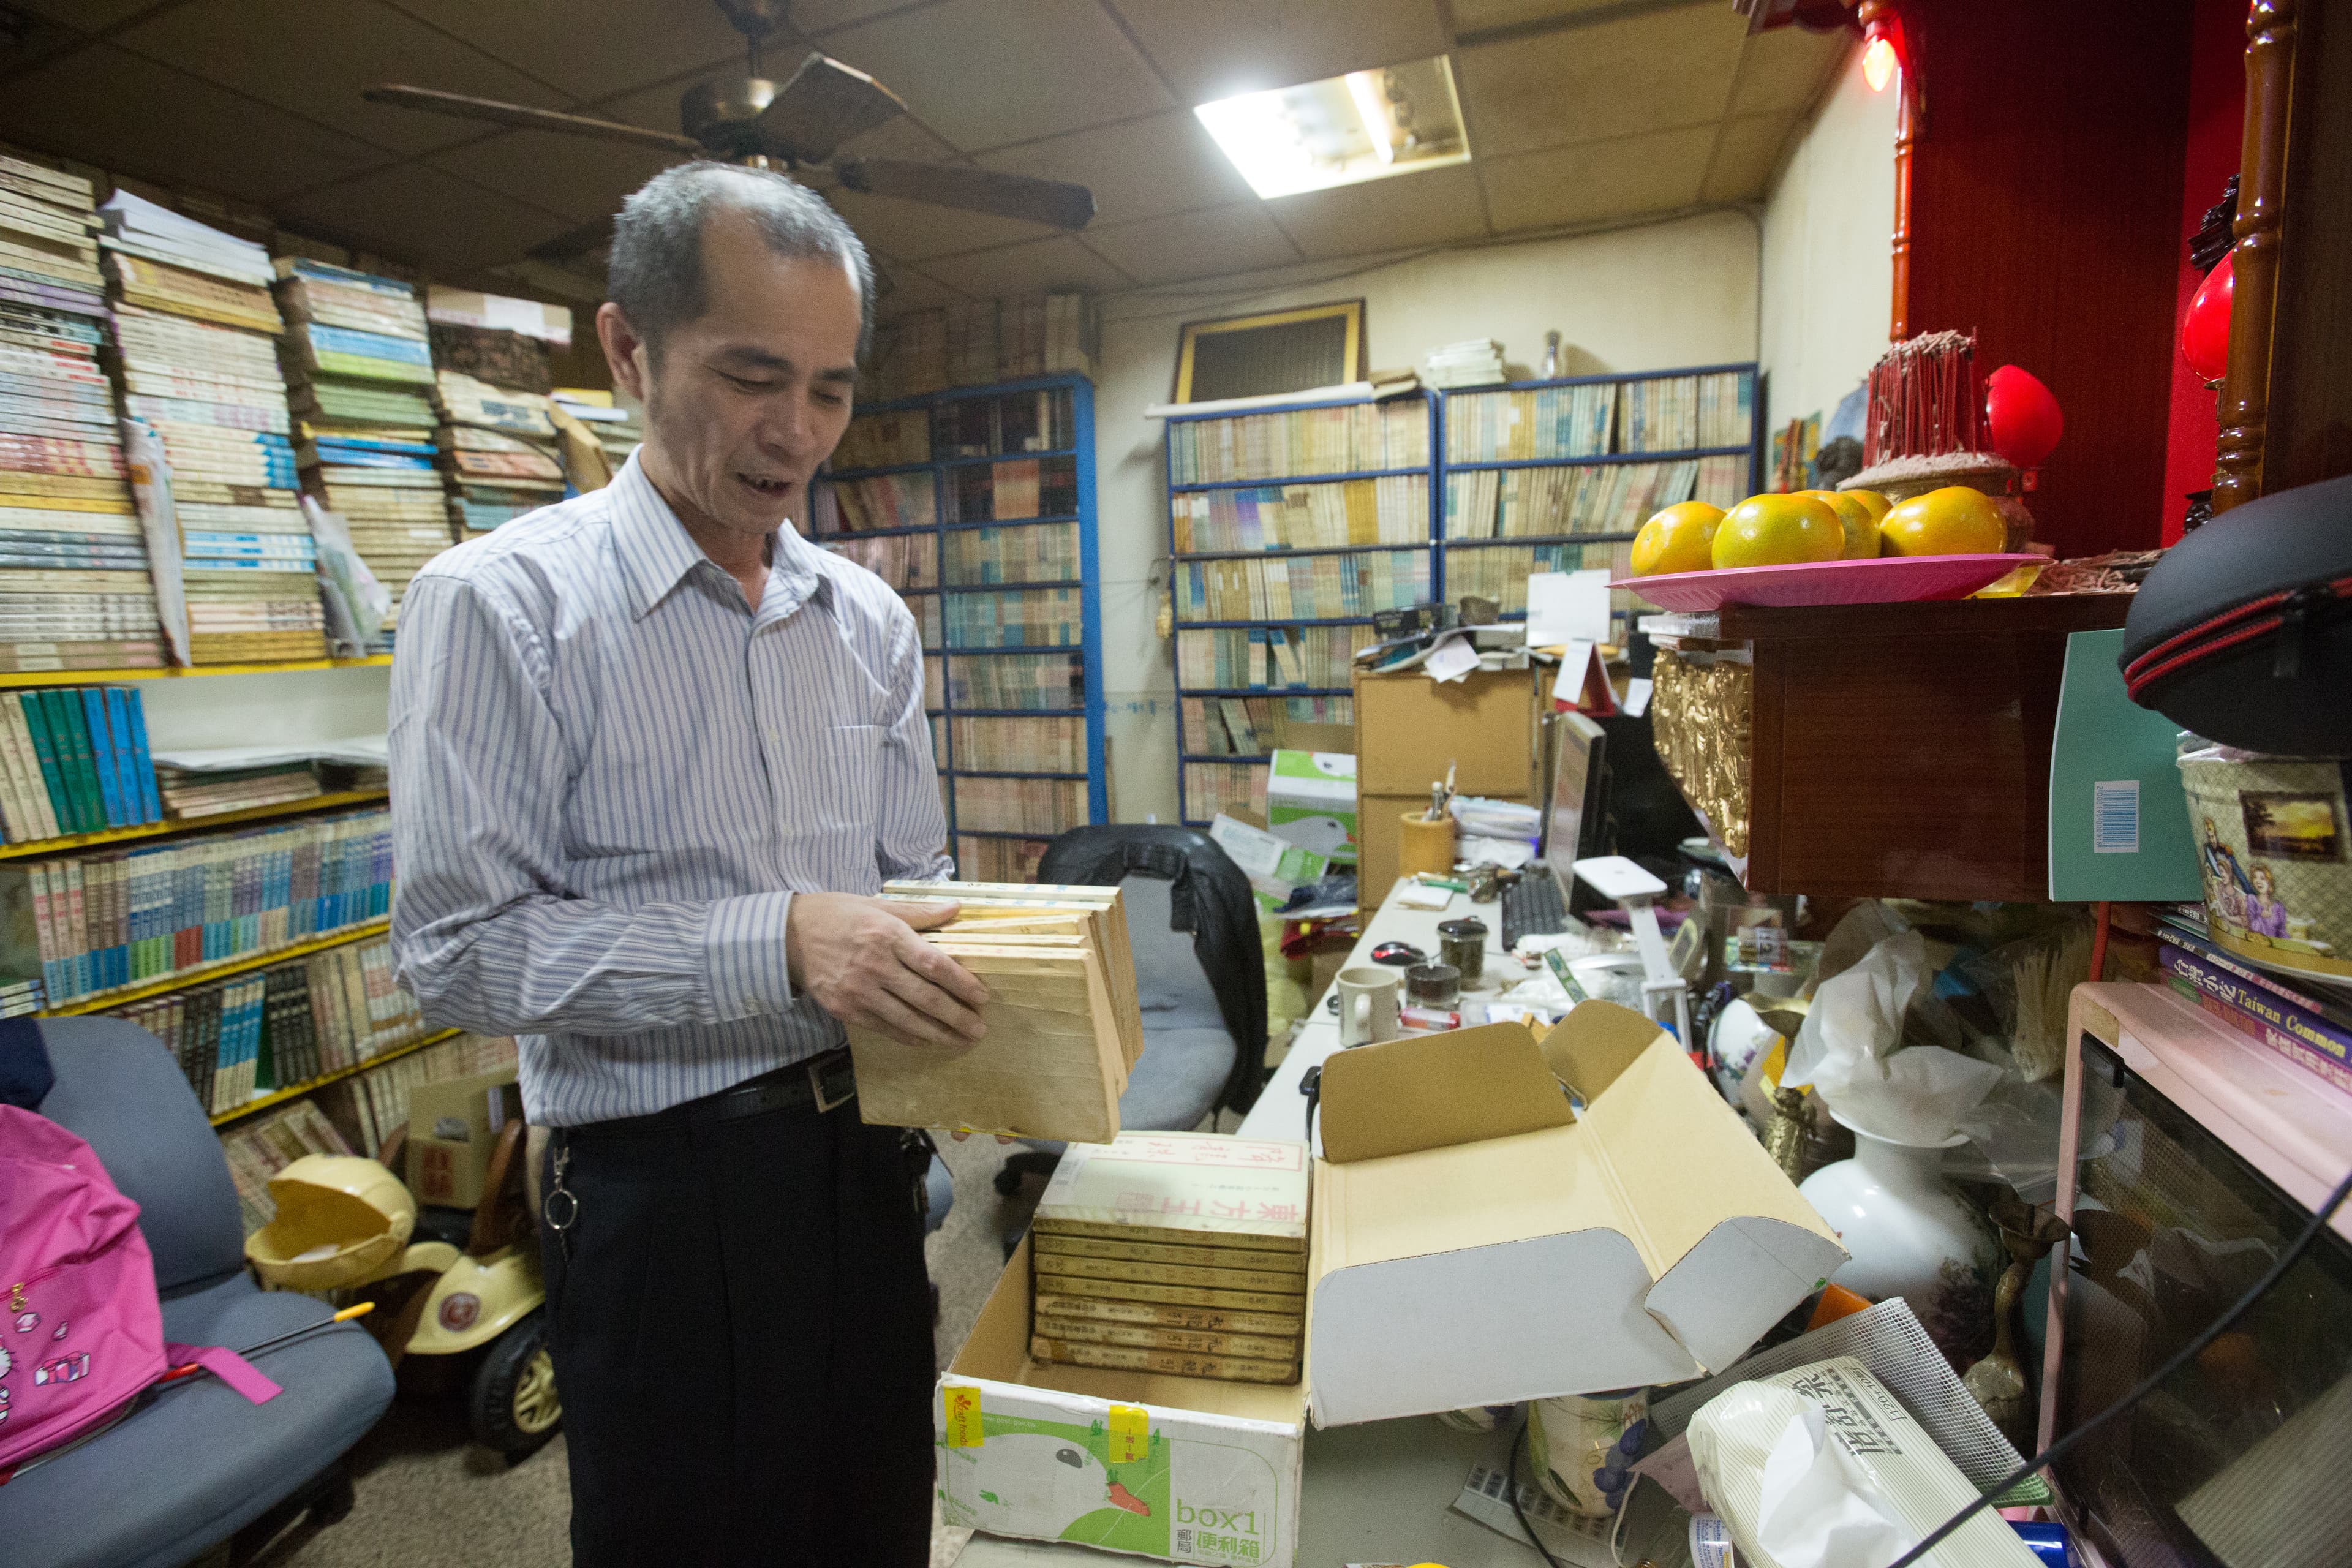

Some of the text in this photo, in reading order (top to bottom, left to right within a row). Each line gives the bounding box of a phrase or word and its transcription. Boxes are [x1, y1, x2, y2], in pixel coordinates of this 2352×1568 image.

[2238, 989, 2280, 1024] Taiwan
[2286, 1015, 2346, 1058] Common
[1161, 1196, 1299, 1221] 東方玉
[1177, 1499, 1259, 1535] box1
[1177, 1529, 1191, 1553] 郵局
[1196, 1531, 1260, 1559] 便利箱
